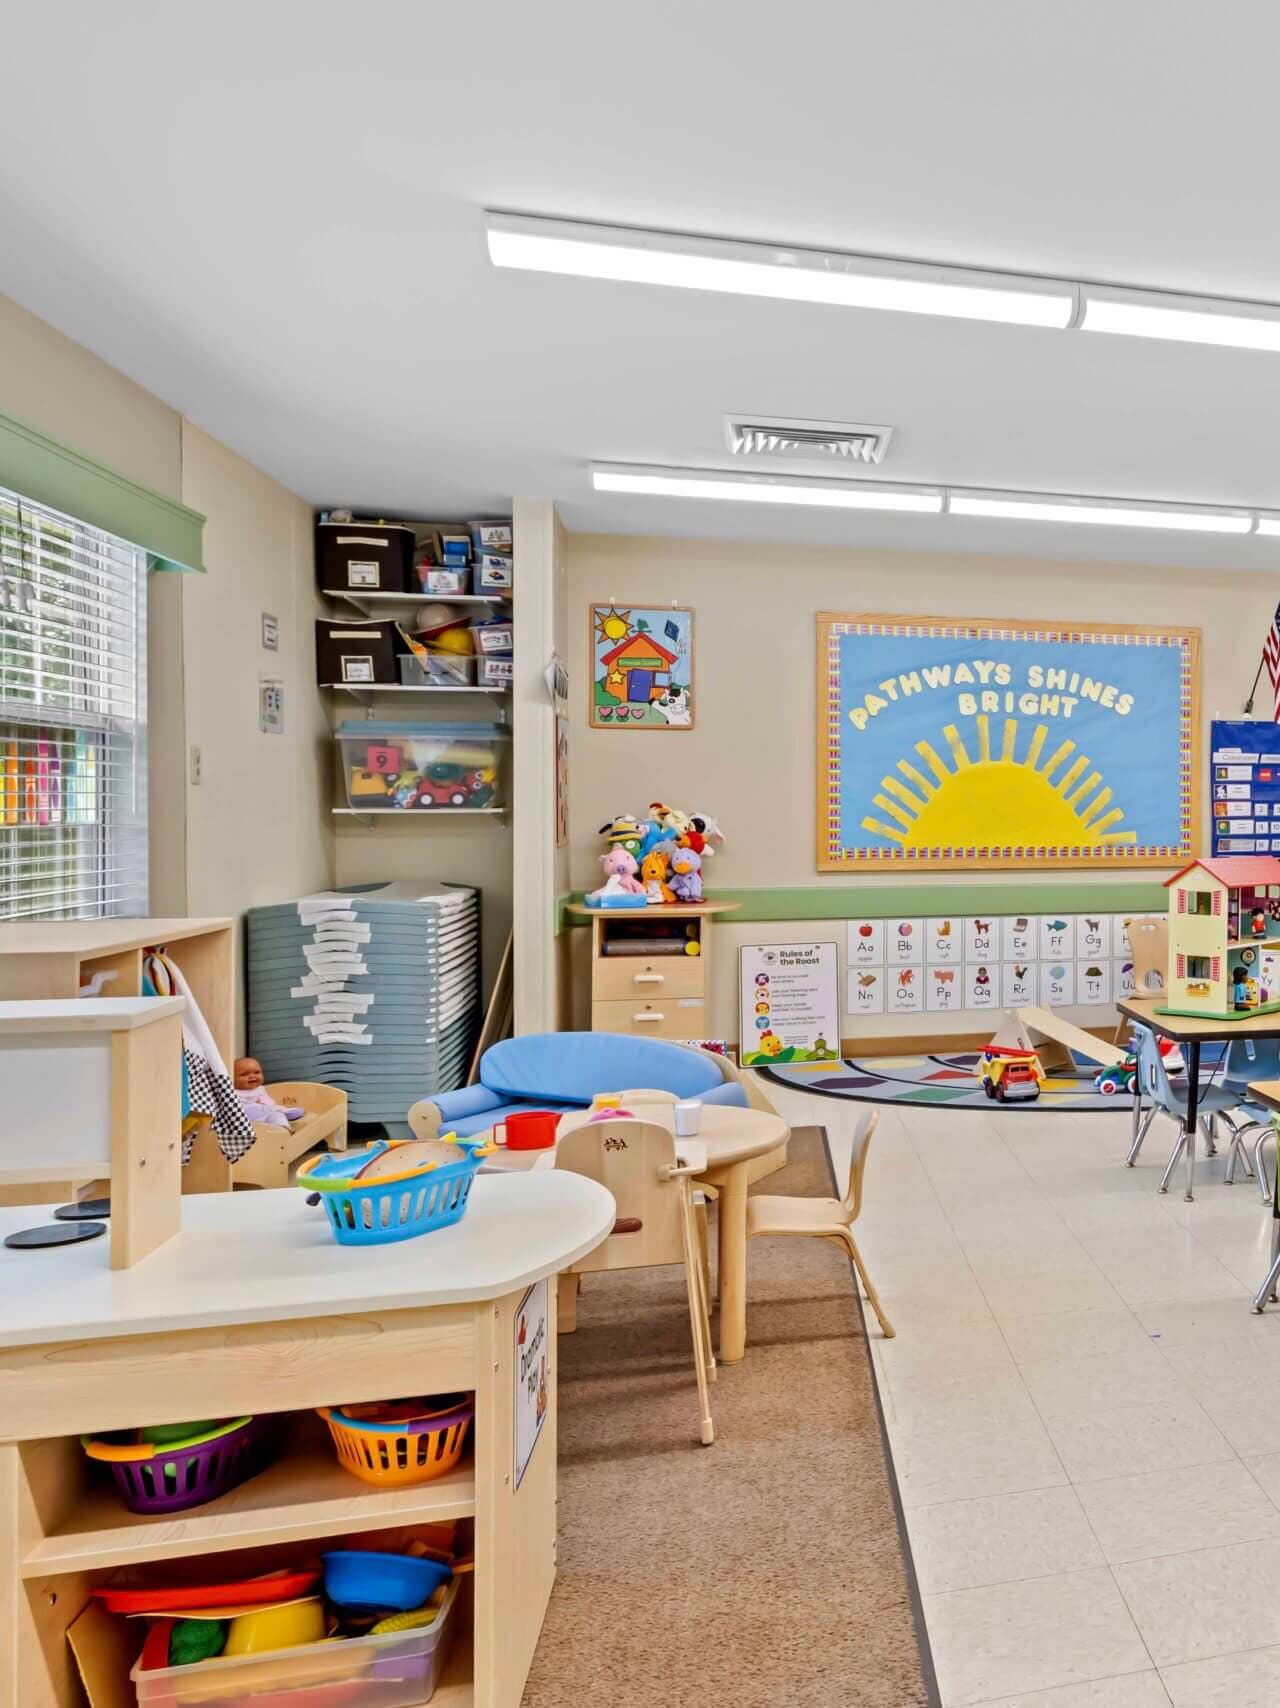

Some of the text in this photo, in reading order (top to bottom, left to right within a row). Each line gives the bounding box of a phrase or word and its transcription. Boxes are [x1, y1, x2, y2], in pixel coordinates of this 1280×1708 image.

[849, 660, 1134, 730] PATHWAYS SHINES
[958, 690, 1079, 718] BRIGHT
[897, 941, 912, 951] Bb
[936, 939, 951, 950] Cc
[974, 938, 989, 949] Dd
[1014, 938, 1027, 948] Ee
[1051, 936, 1063, 947] Ff
[1085, 934, 1101, 948] Gg
[857, 942, 874, 952] Aa
[796, 957, 820, 965] Roost
[1261, 975, 1272, 986] Yy
[974, 985, 991, 998] Qq
[1013, 984, 1026, 994] Rr
[1051, 982, 1063, 993] Ss
[1085, 981, 1101, 992] Tt
[858, 990, 873, 1000] Nn
[897, 988, 914, 998] Oo
[937, 987, 951, 1000] Pp
